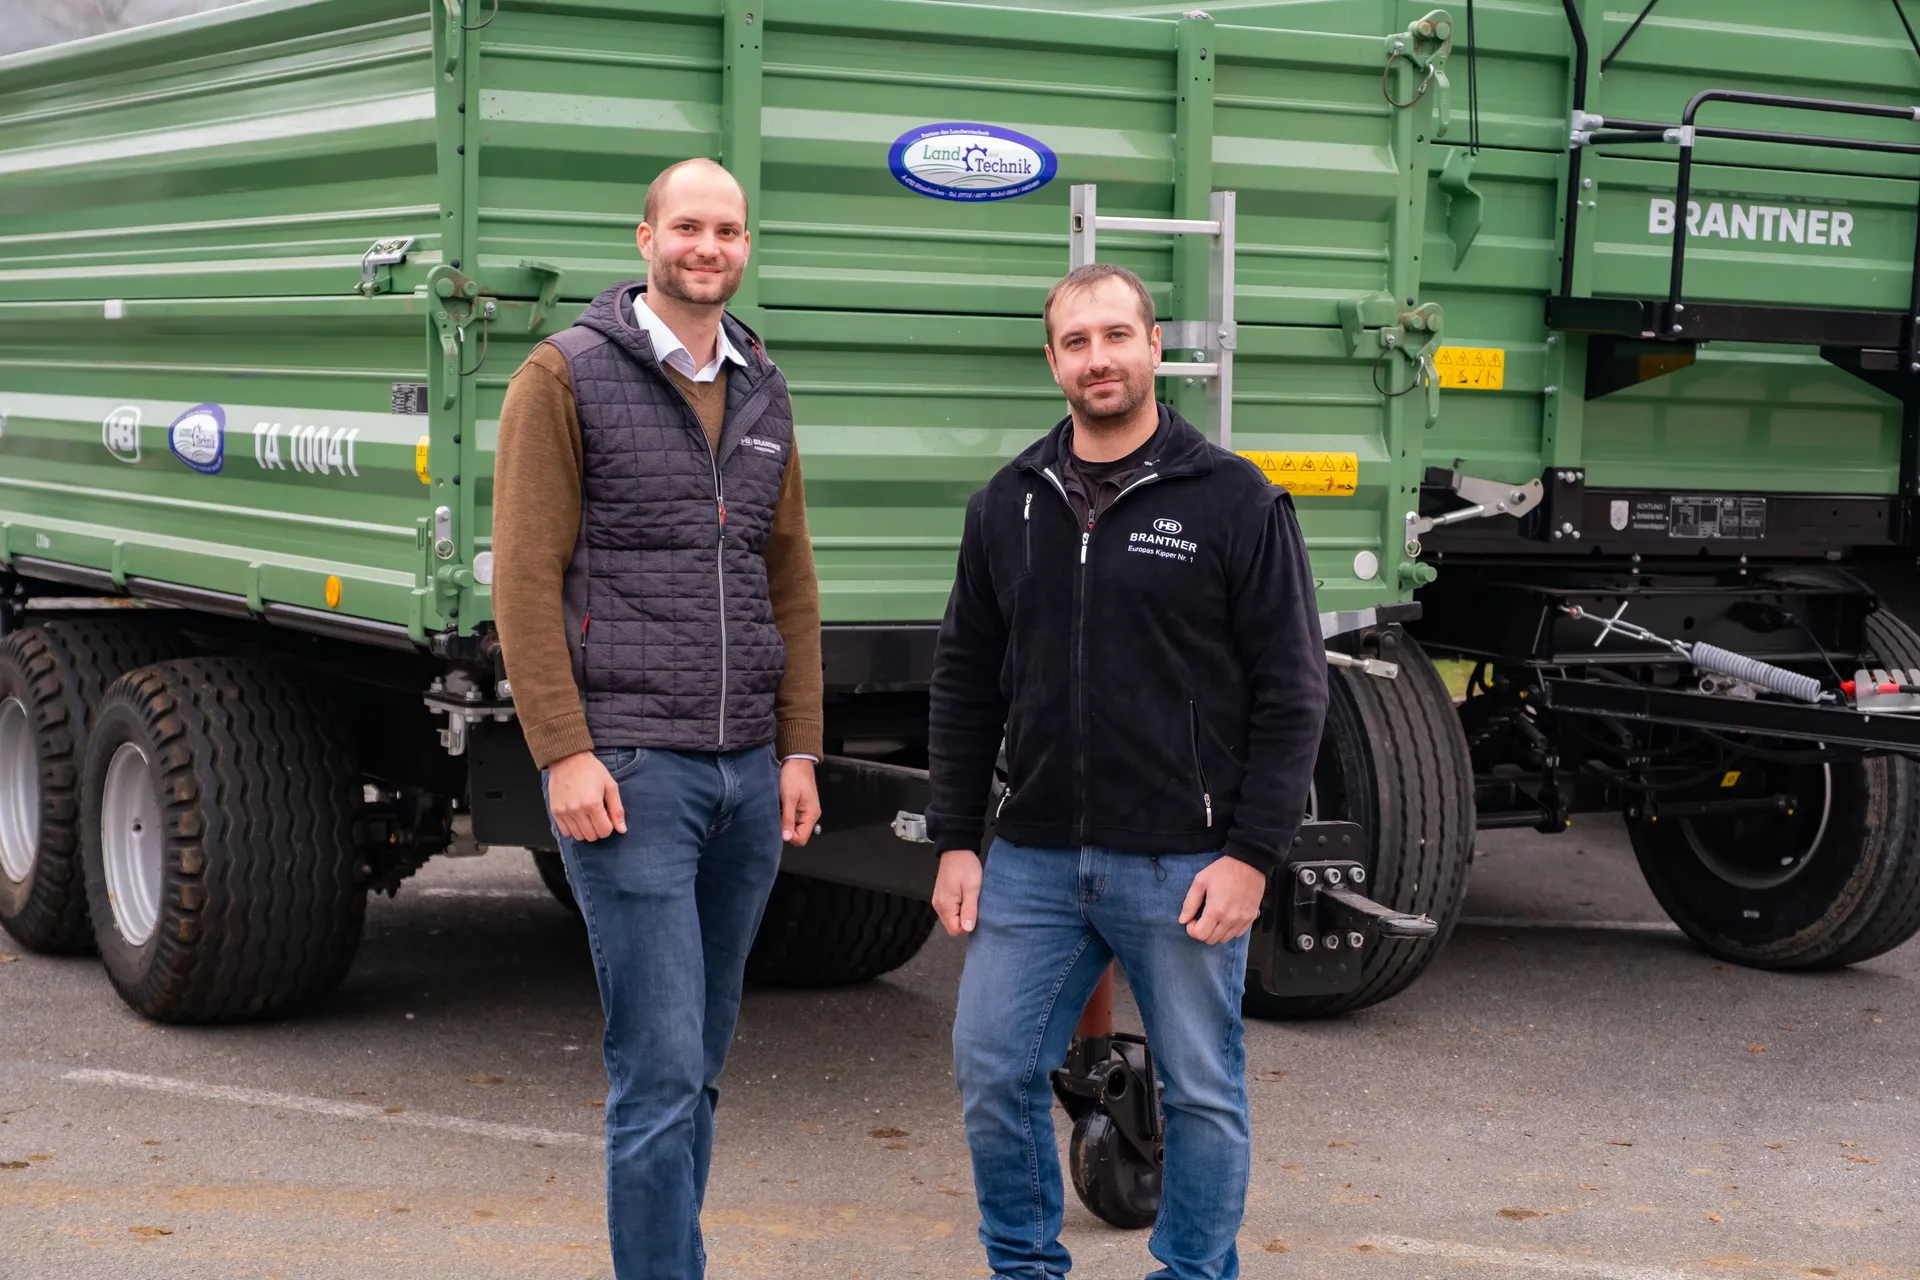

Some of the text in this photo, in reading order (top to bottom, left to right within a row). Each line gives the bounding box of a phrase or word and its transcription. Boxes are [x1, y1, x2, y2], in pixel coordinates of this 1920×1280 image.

[922, 144, 961, 161] Land
[974, 157, 1032, 175] Technik
[1648, 198, 1854, 247] BRANTNER
[252, 422, 286, 470] TA
[287, 424, 360, 477] 10041
[1158, 520, 1178, 532] HB
[1129, 532, 1198, 553] BRANTNER
[1127, 544, 1154, 555] Europas
[1155, 548, 1177, 559] Kipper
[1177, 553, 1188, 562] Nr.
